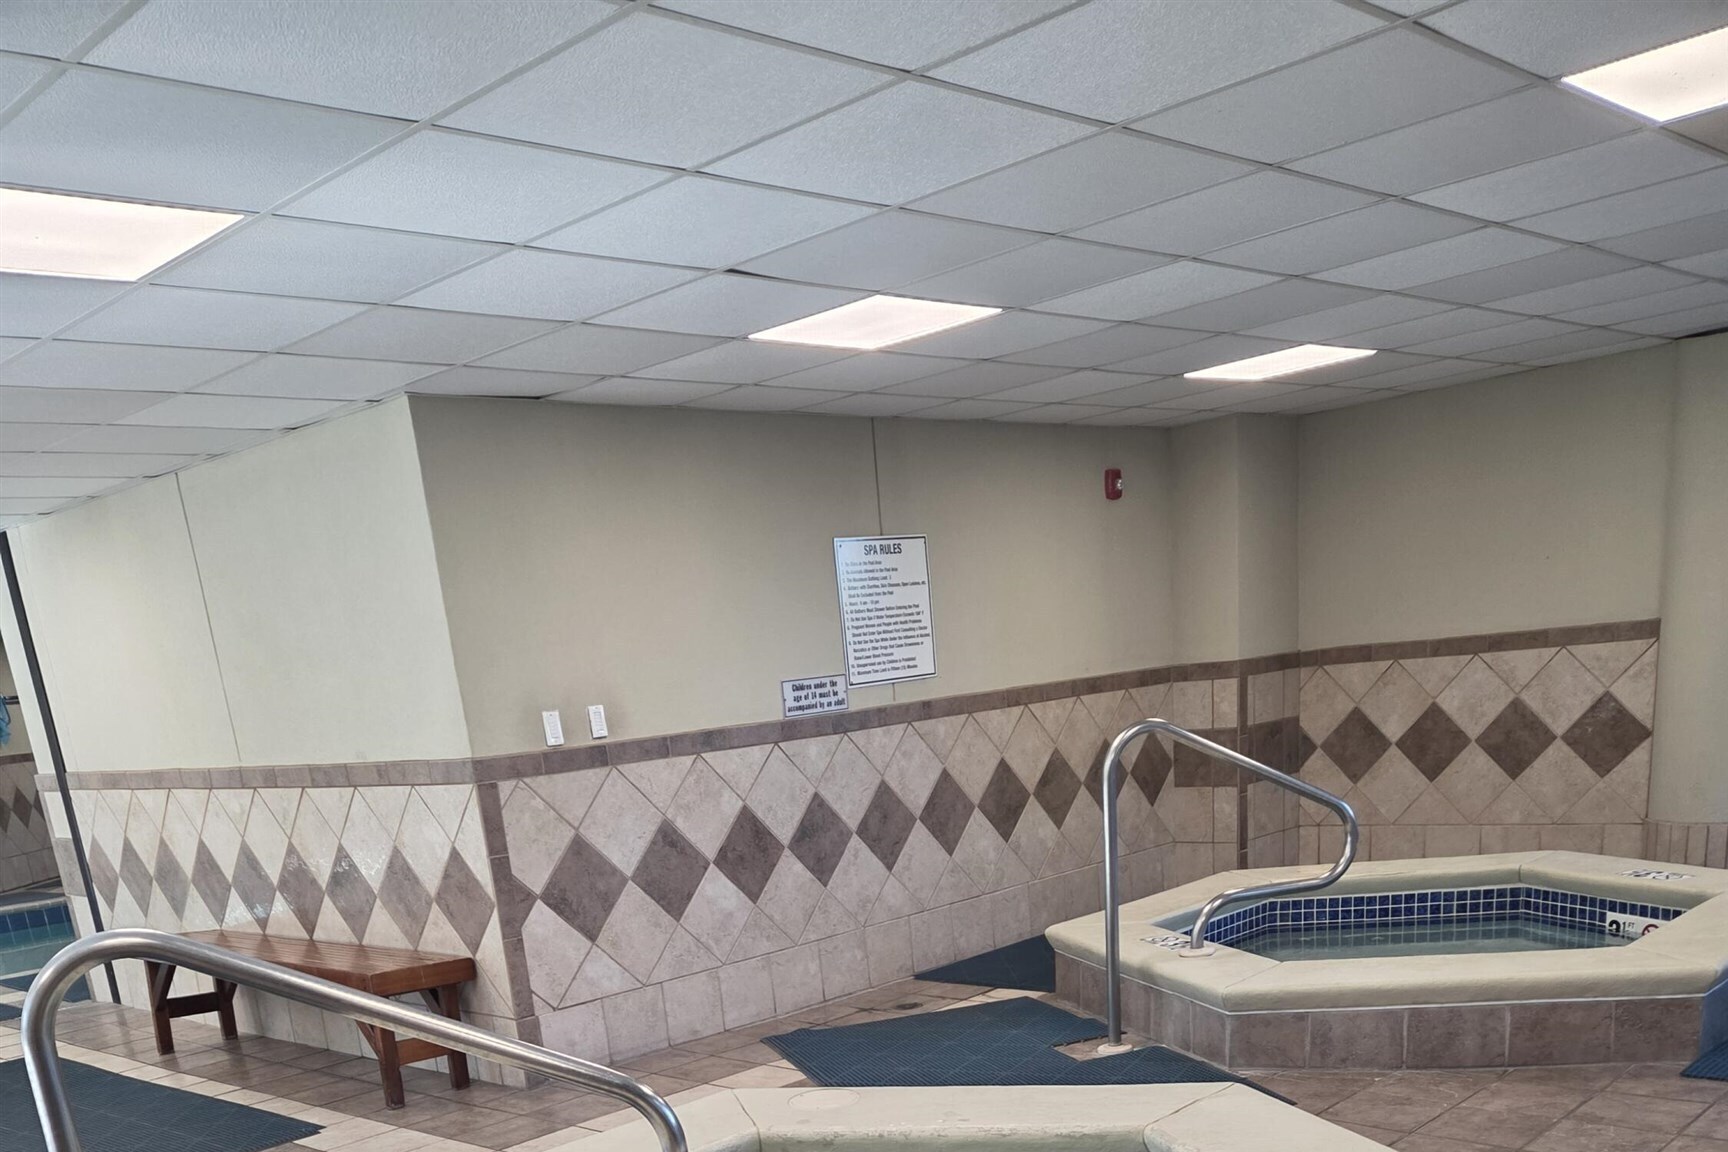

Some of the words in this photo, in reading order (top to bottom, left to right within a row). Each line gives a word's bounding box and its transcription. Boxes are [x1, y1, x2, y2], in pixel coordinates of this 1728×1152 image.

[864, 544, 878, 555] SPA
[880, 543, 902, 554] RULES
[792, 683, 812, 692] Children
[814, 681, 828, 690] under
[804, 693, 810, 701] of
[819, 690, 831, 698] must
[833, 689, 839, 697] be
[788, 701, 818, 713] accompanied
[820, 701, 825, 709] by
